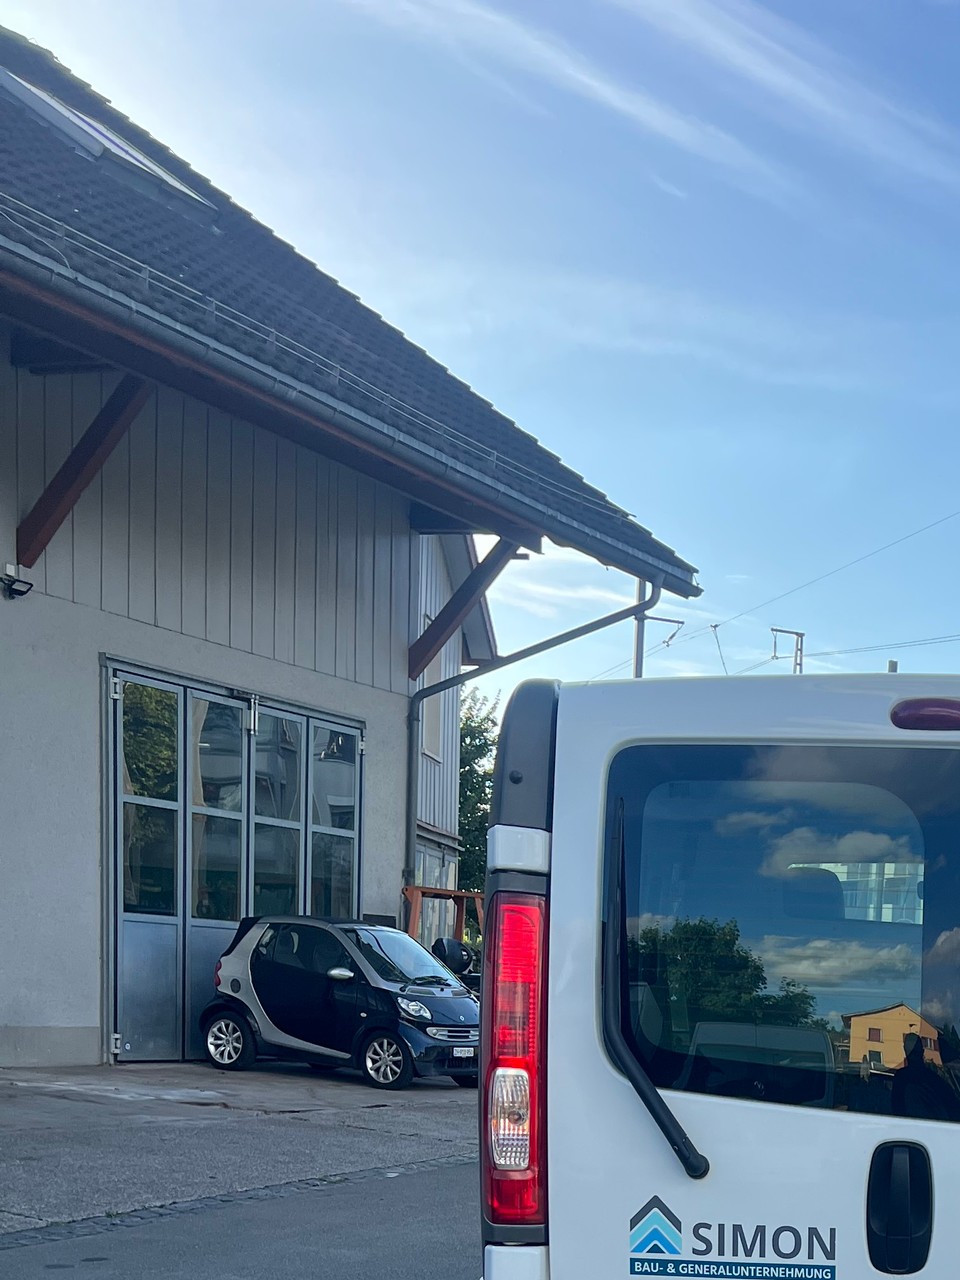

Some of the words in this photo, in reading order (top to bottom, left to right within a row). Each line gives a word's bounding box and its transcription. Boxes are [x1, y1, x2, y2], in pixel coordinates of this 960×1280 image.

[692, 1222, 836, 1261] SIMON
[634, 1262, 664, 1273] BAU-
[667, 1263, 676, 1274] &
[679, 1263, 832, 1280] GENERALUNTERNEHMUNG
